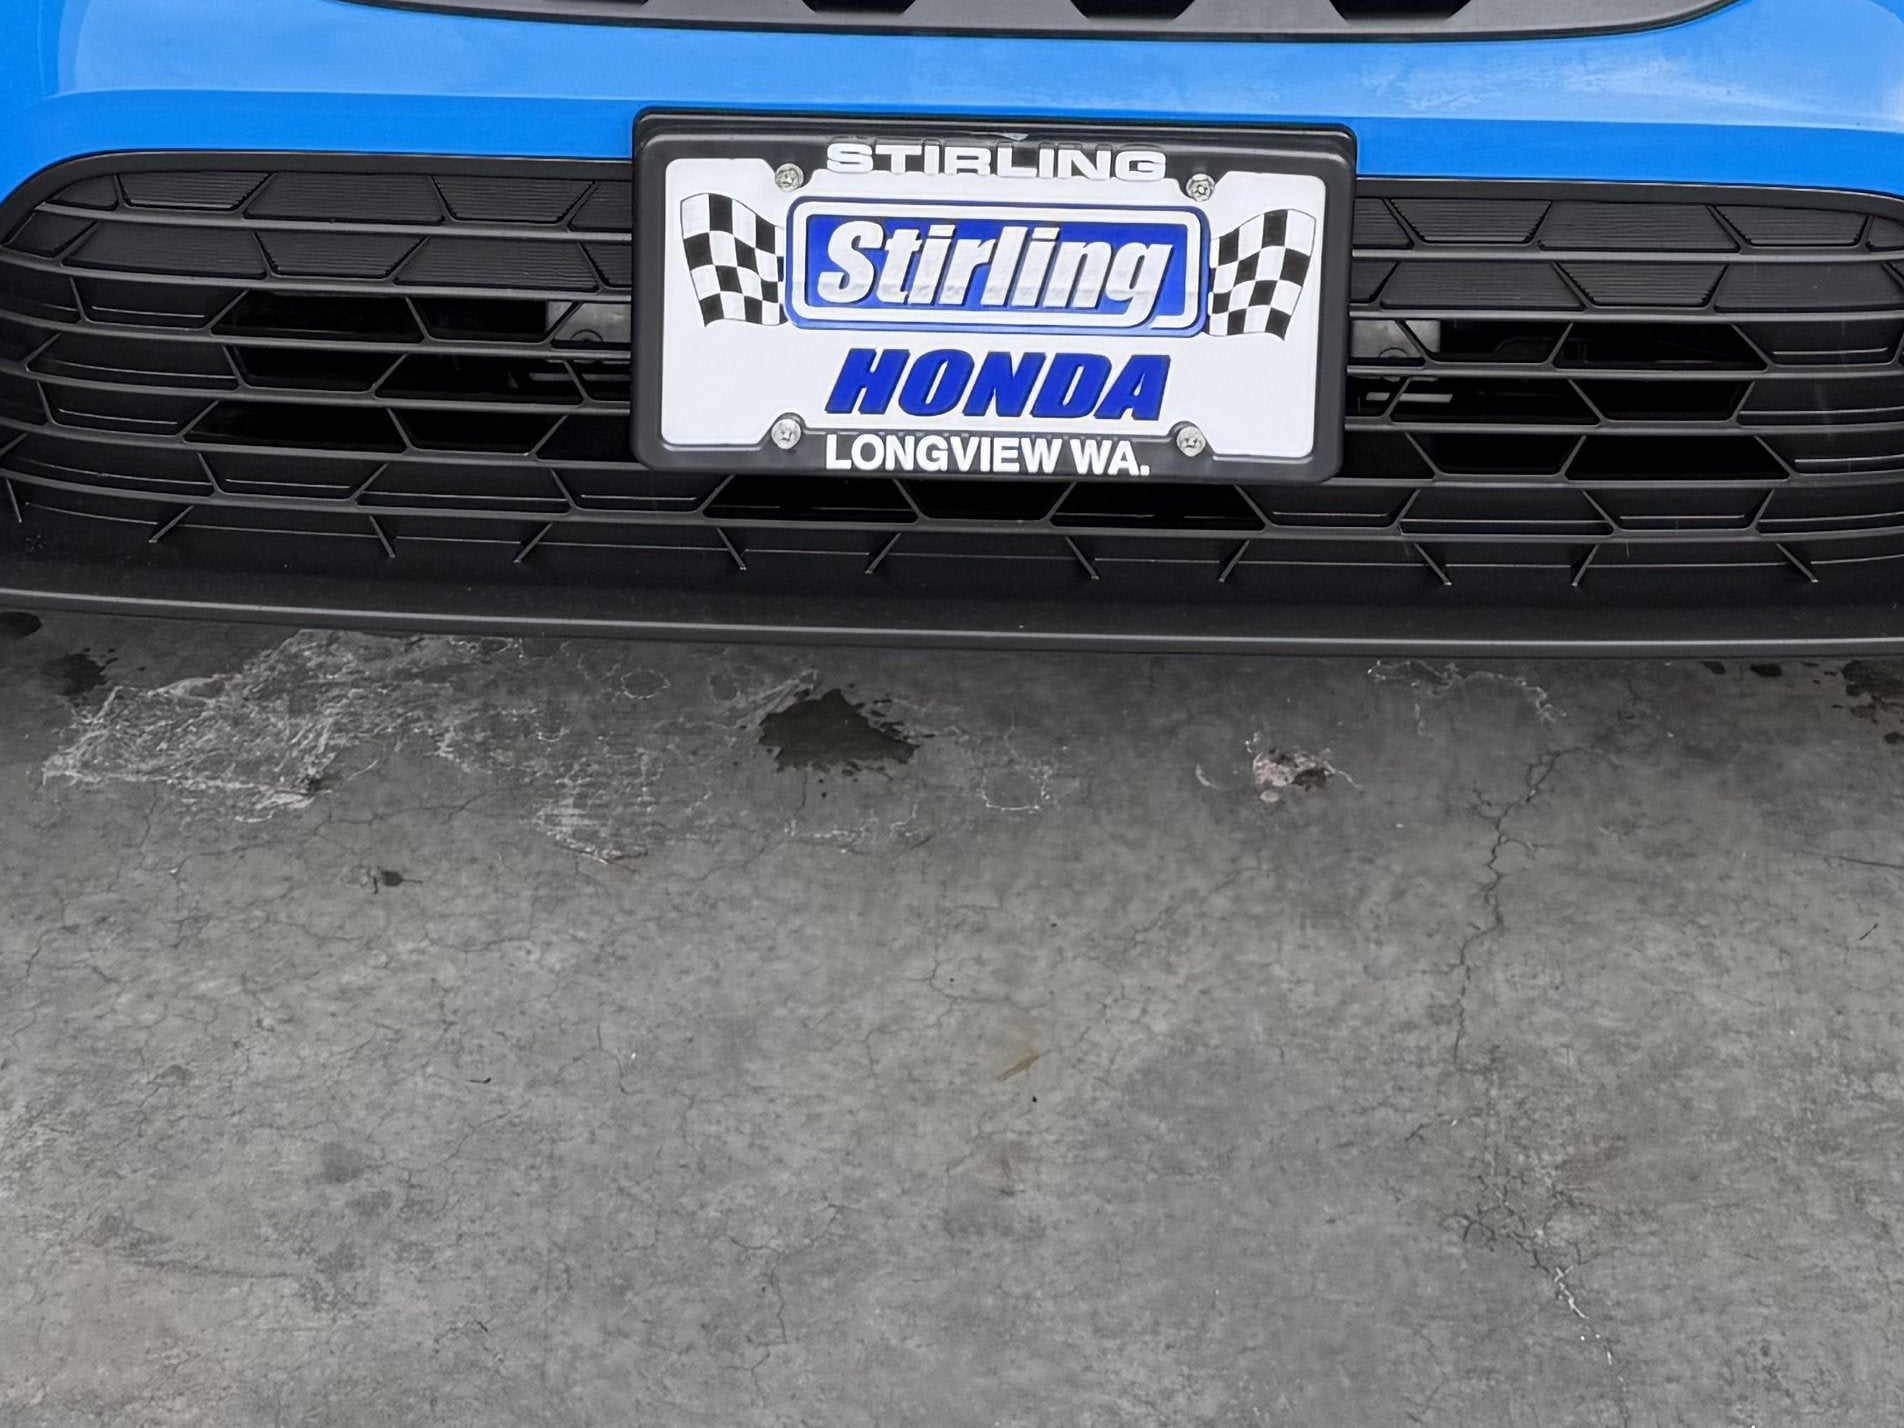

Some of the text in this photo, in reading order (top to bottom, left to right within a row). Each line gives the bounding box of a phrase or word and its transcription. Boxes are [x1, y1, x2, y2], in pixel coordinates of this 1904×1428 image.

[826, 142, 1167, 182] STIRLING
[817, 219, 1173, 320] Stirling
[824, 347, 1171, 421] HONDA
[825, 432, 1151, 476] LONGVIEW WA.
